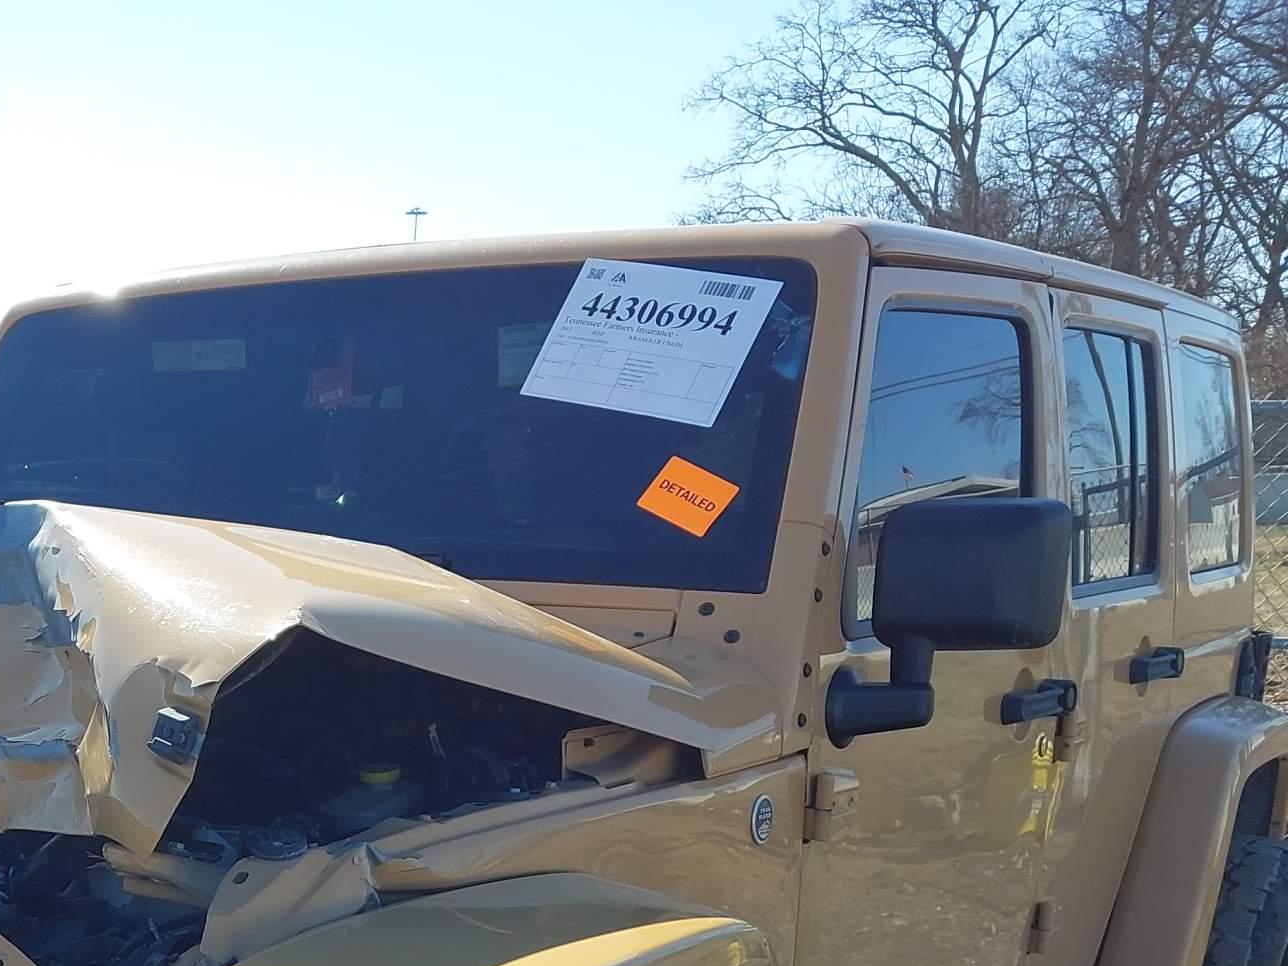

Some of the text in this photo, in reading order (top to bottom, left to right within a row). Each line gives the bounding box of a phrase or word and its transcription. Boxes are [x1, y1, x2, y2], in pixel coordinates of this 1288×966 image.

[564, 316, 601, 328] Tennessee
[603, 321, 634, 332] Farmers
[636, 326, 674, 338] Insurance
[581, 292, 738, 336] 44306994
[659, 479, 716, 513] DETAILED
